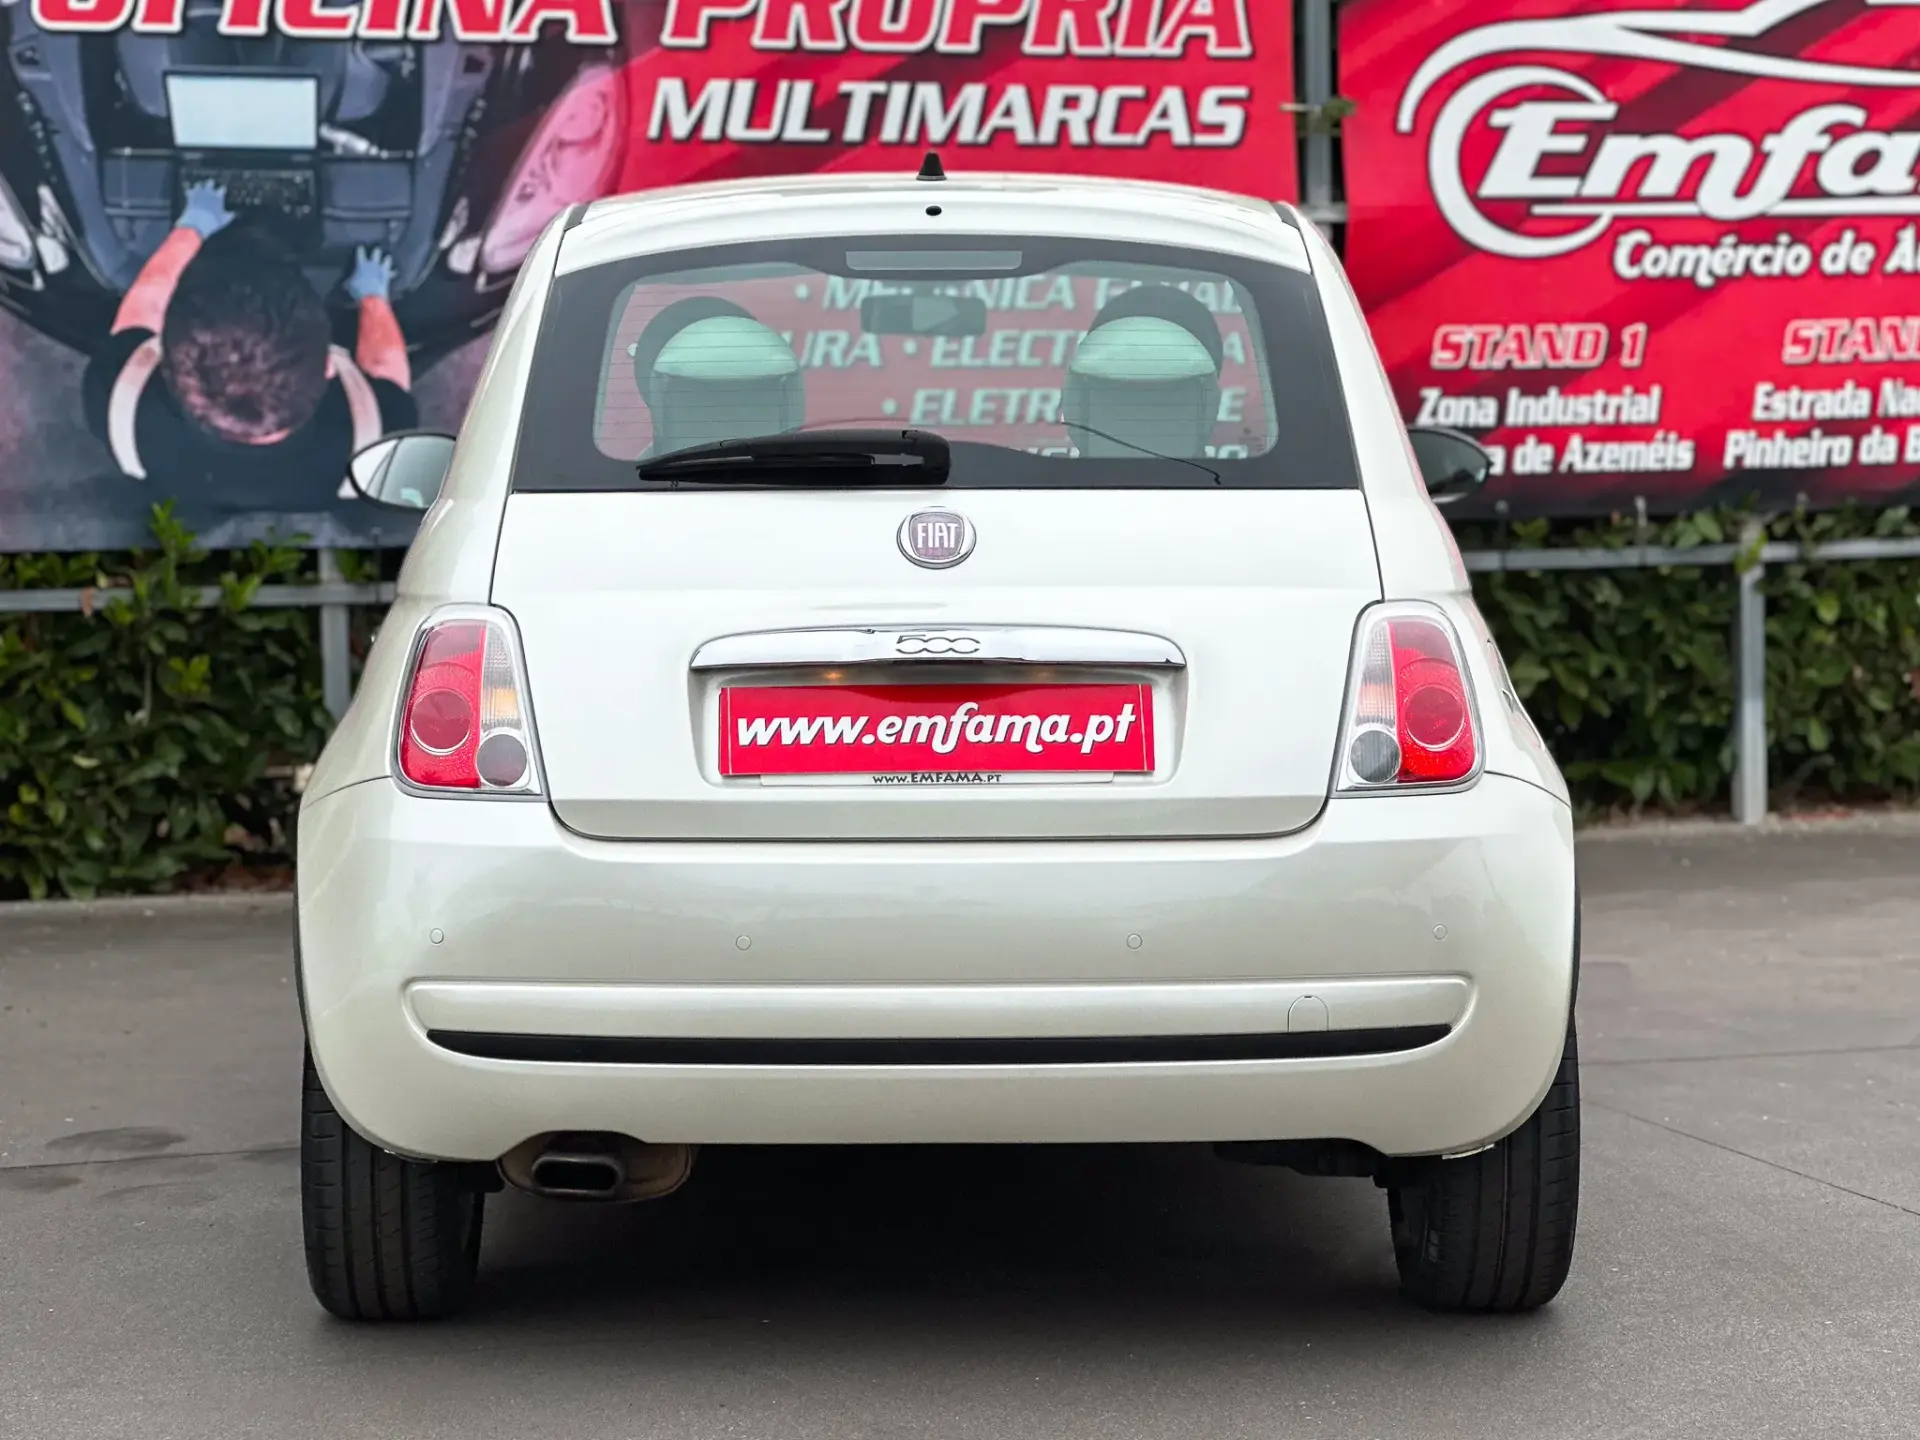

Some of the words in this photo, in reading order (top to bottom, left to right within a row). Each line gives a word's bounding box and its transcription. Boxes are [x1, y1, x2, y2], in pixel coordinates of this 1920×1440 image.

[646, 76, 1249, 147] MULTIMARCAS
[1477, 100, 1920, 219] Emfa
[1613, 228, 1812, 287] Comércio
[1820, 228, 1876, 276] de
[1430, 322, 1609, 370] STAND
[1620, 321, 1648, 368] 1
[1781, 316, 1920, 366] STAN
[1415, 387, 1498, 427] Zona
[1504, 383, 1662, 427] Industrial
[1752, 379, 1872, 421] Estrada
[1512, 434, 1555, 475] de
[1558, 430, 1695, 473] Azeméis
[1722, 427, 1853, 470] Pinheiro
[1857, 424, 1899, 466] da
[916, 522, 959, 549] FIAT
[895, 633, 981, 655] 500
[737, 702, 1137, 755] www.emfama.pt
